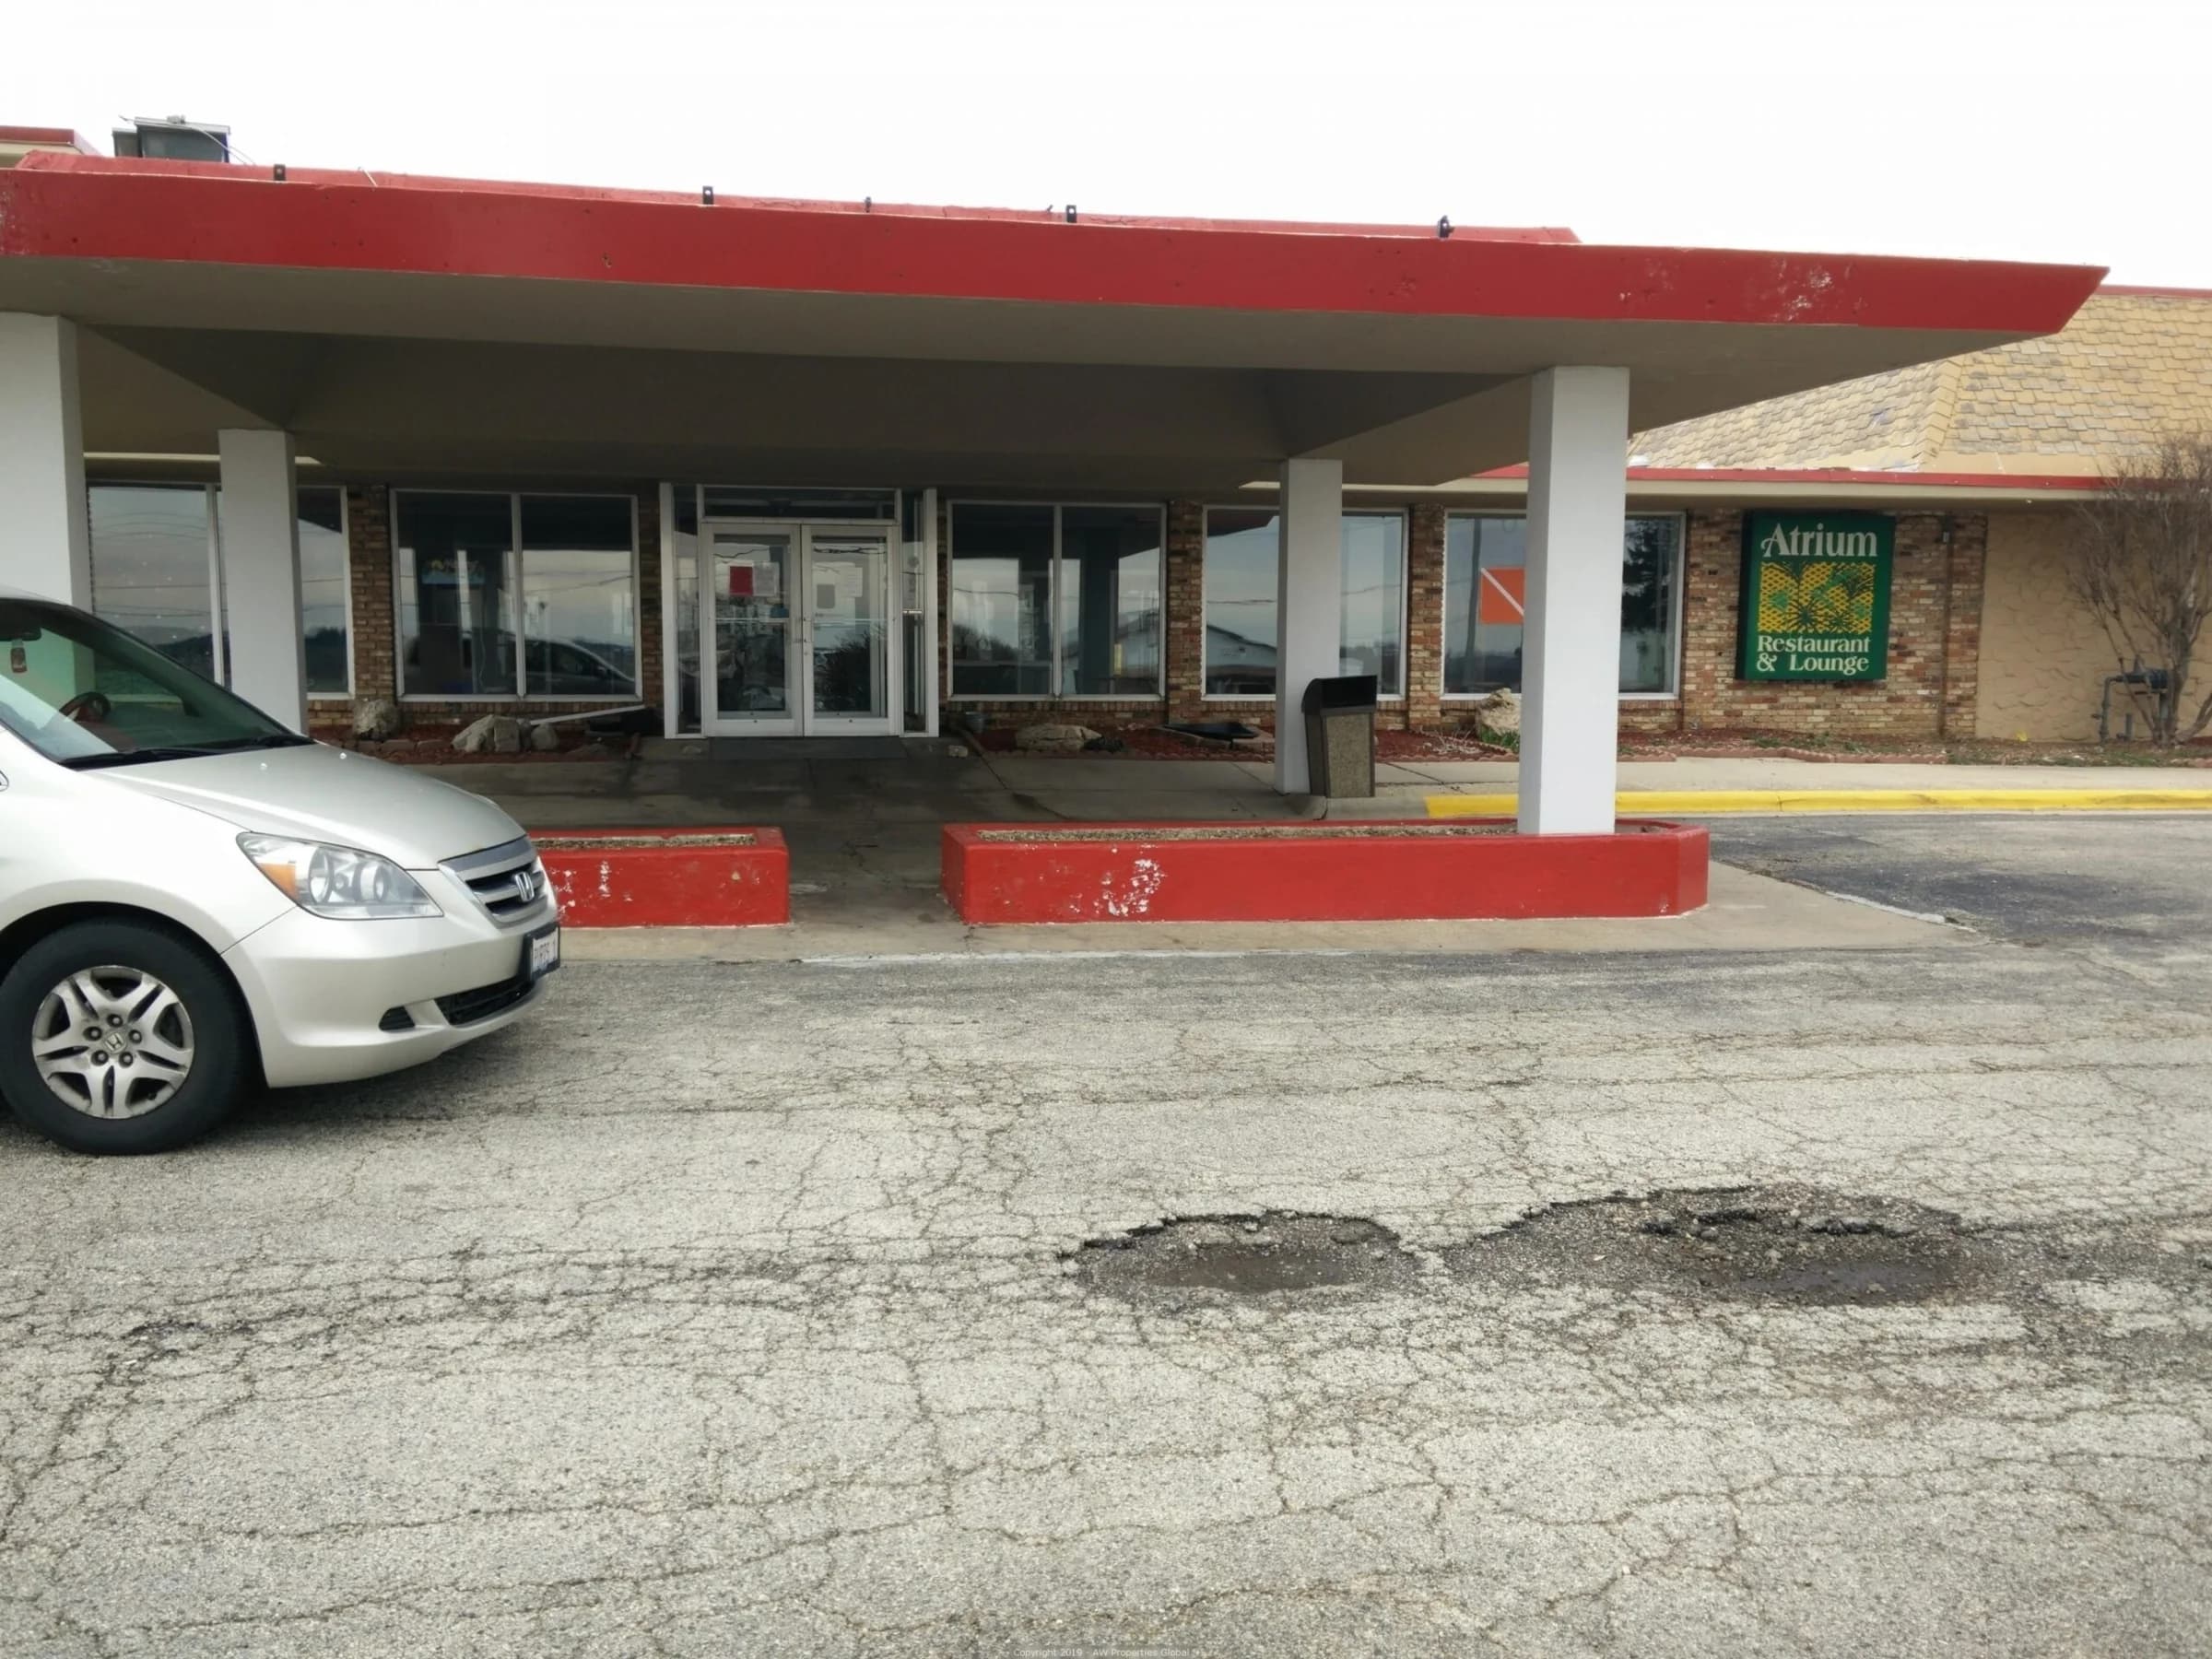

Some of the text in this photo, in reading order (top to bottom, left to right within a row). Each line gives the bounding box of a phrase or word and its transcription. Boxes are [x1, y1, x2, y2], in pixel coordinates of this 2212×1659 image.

[1760, 523, 1878, 558] Atrium
[1757, 635, 1872, 653] Restaurant
[1756, 653, 1870, 677] & Lounge
